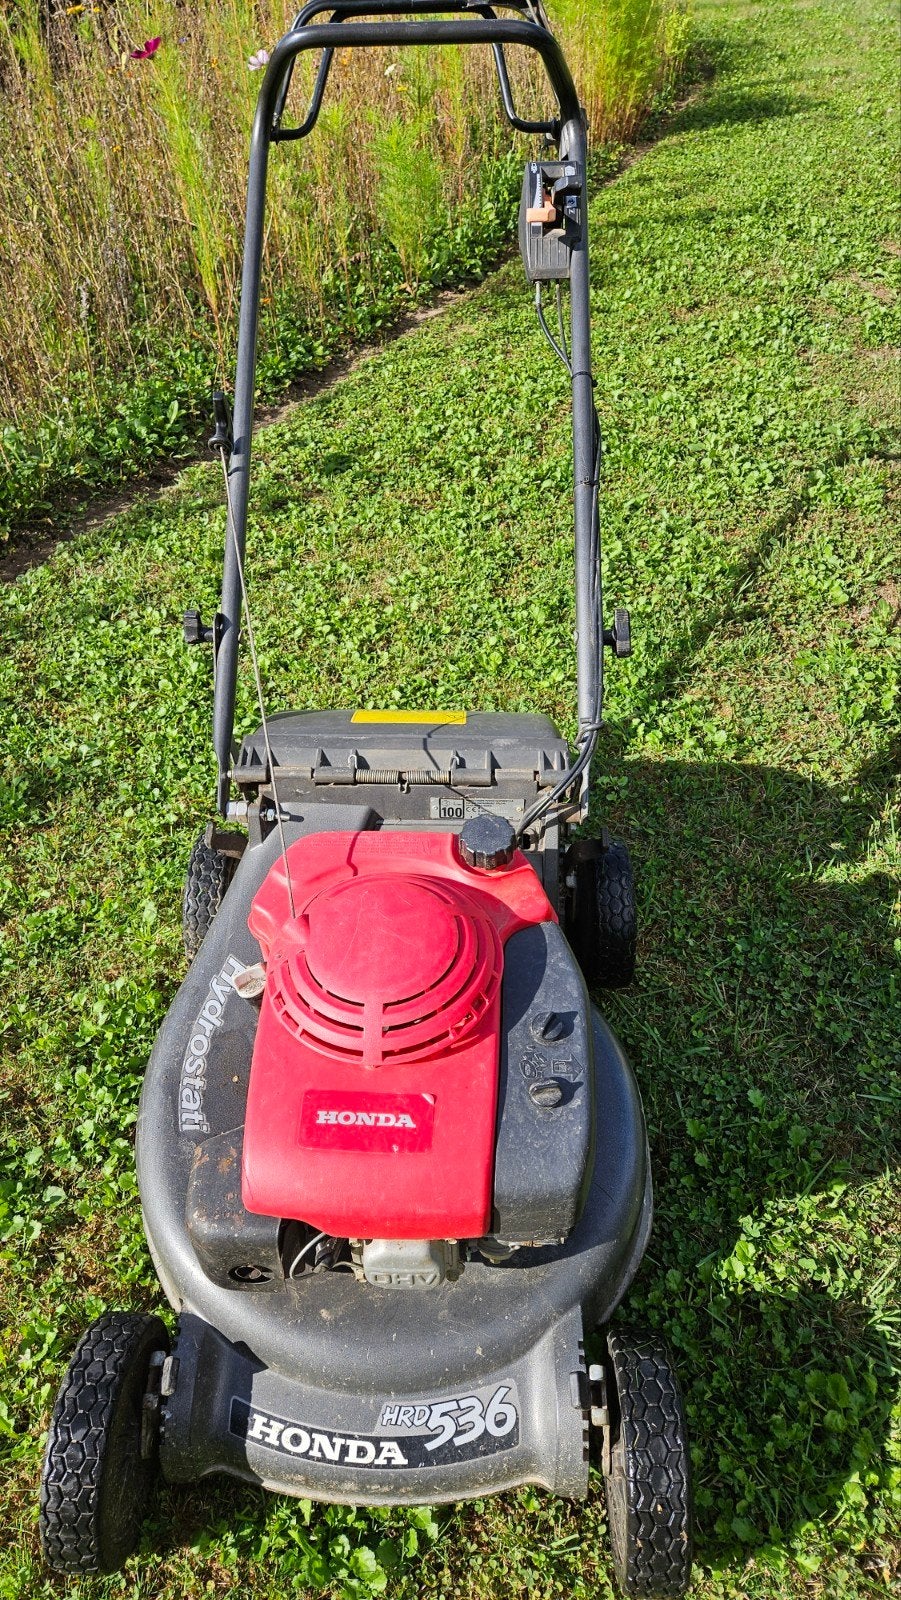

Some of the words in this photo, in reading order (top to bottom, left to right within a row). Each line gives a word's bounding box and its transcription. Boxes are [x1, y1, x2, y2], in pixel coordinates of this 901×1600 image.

[441, 806, 462, 818] 100
[316, 1110, 416, 1128] HONDA
[371, 1271, 438, 1286] OHV
[249, 1413, 408, 1465] HONDA
